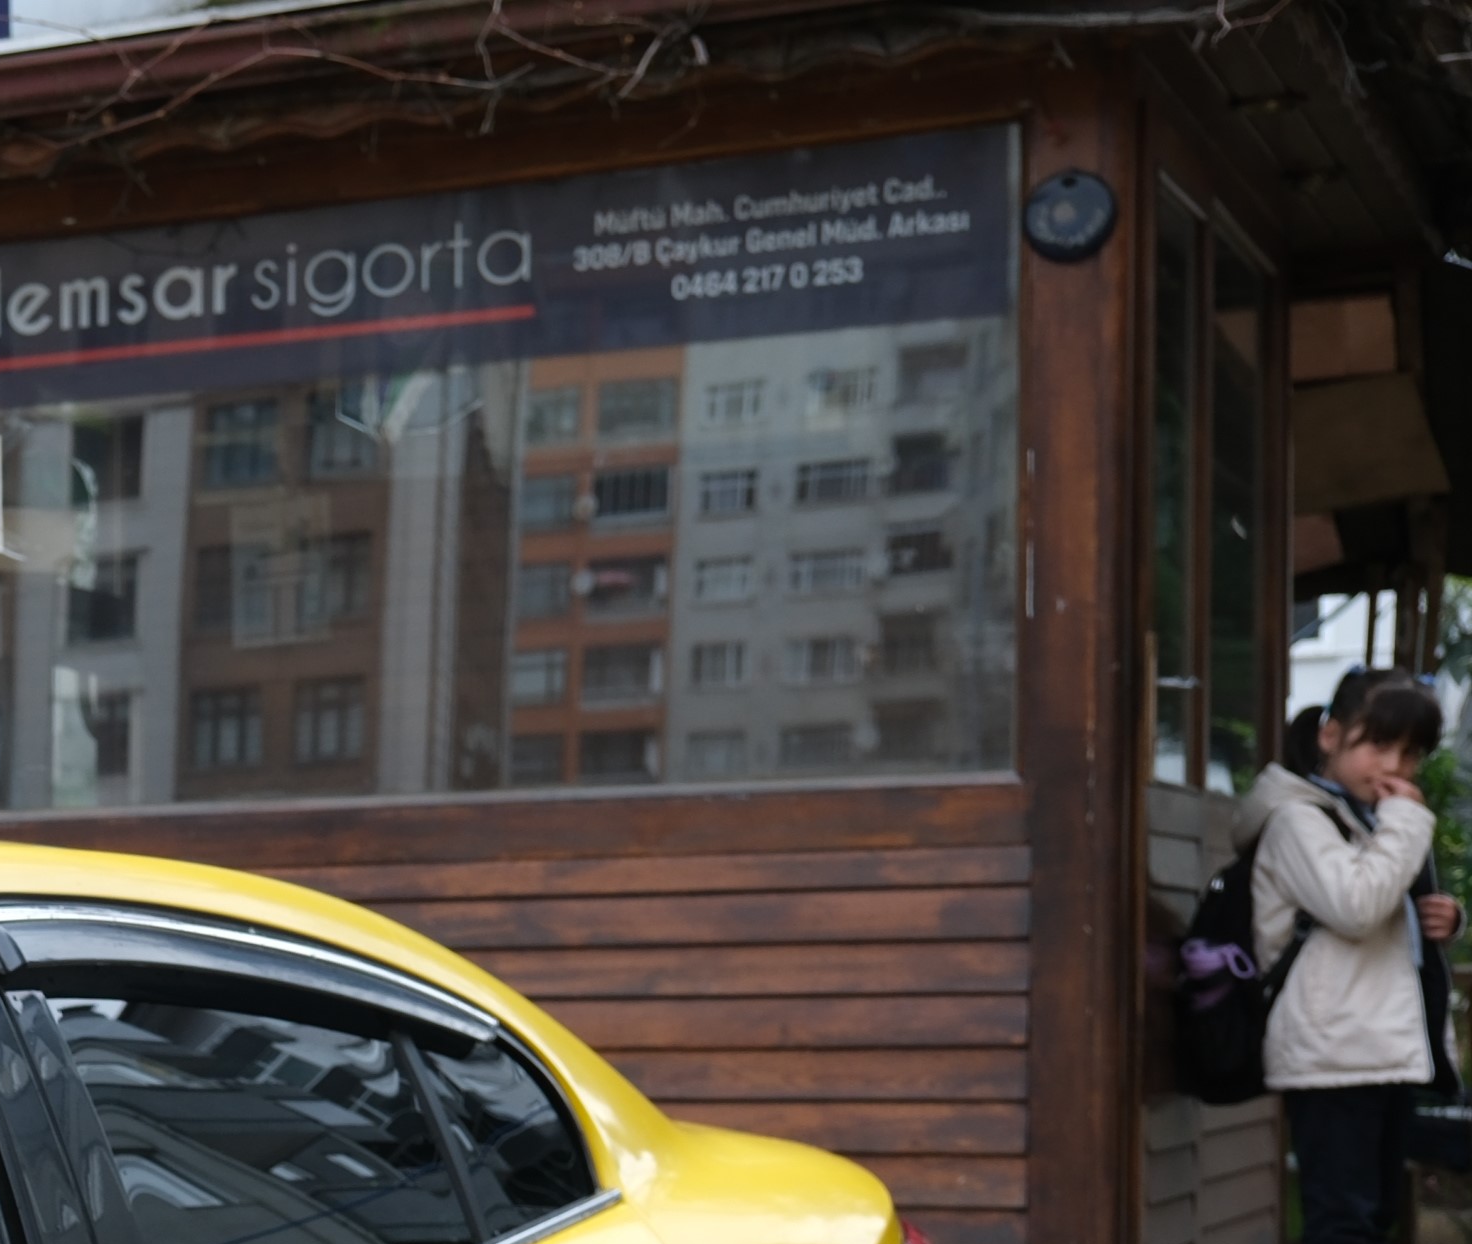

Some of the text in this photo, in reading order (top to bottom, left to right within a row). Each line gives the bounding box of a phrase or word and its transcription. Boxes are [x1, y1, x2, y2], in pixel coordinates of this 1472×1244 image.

[593, 207, 667, 237] Müftü
[671, 201, 726, 227] Mah.
[733, 182, 878, 221] Cumhuriyet
[255, 222, 533, 317] sigorta
[572, 209, 970, 272] 308/B Çaykur Genel Müd. Arkası
[670, 256, 864, 302] 0464 217 0 253
